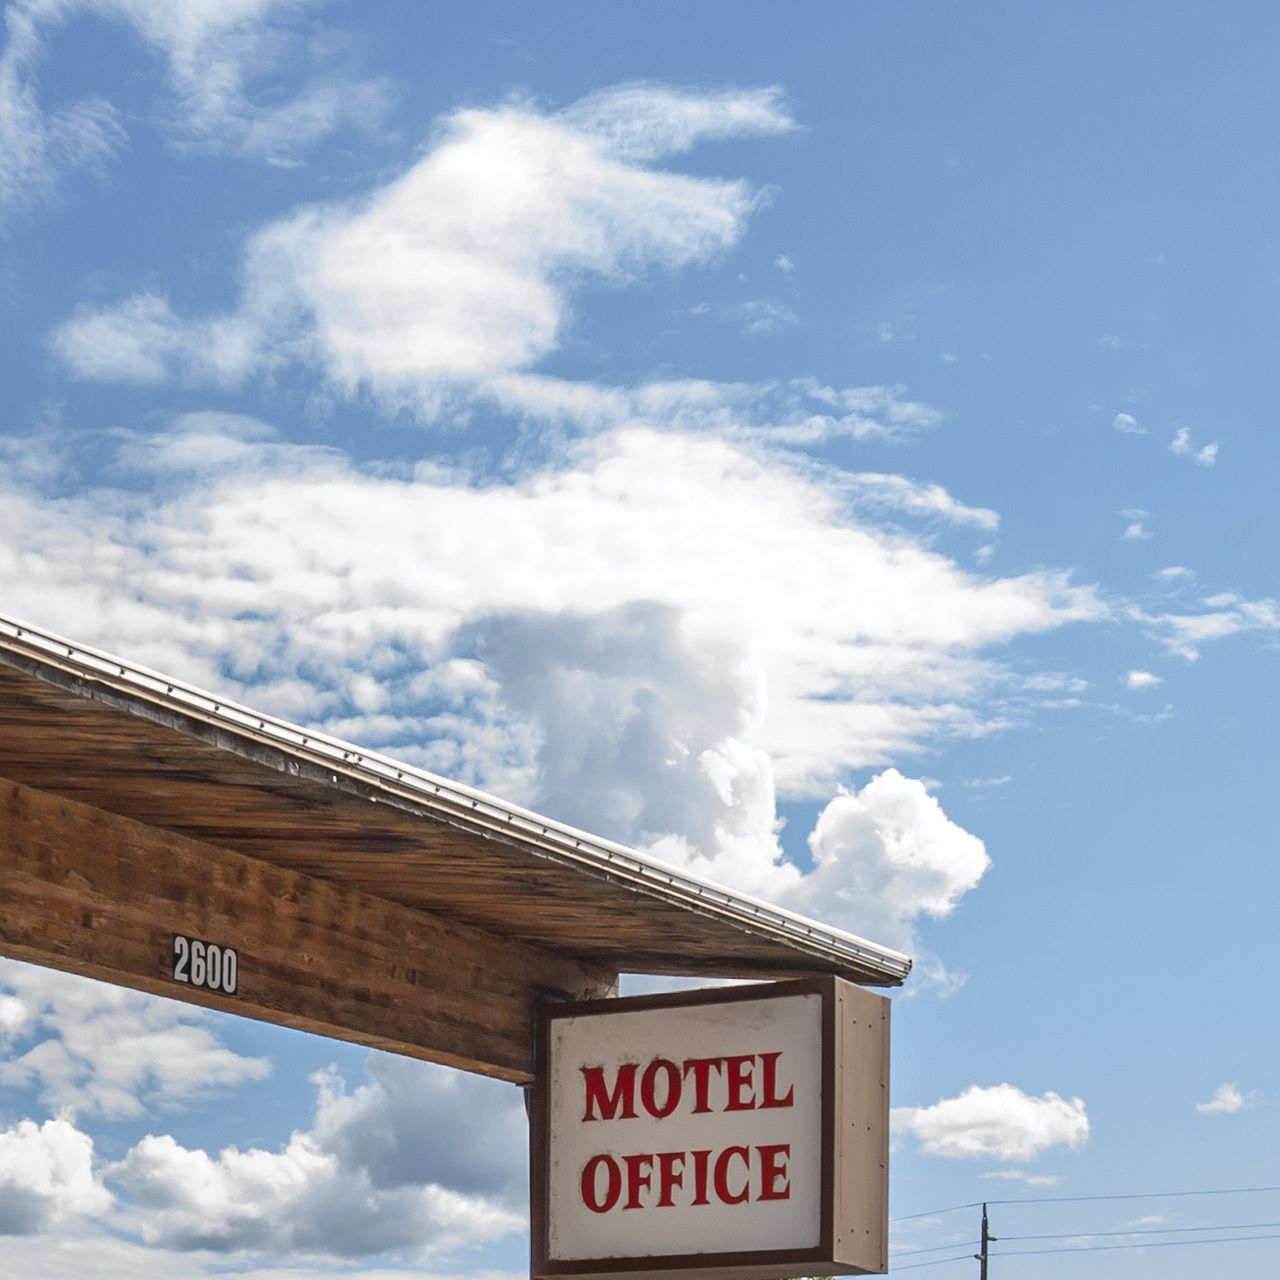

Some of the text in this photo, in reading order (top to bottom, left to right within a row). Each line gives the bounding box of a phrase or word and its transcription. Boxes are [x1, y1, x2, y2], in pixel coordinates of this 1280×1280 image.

[173, 936, 238, 994] 2600
[580, 1051, 794, 1123] MOTEL
[581, 1144, 791, 1214] OFFICE
